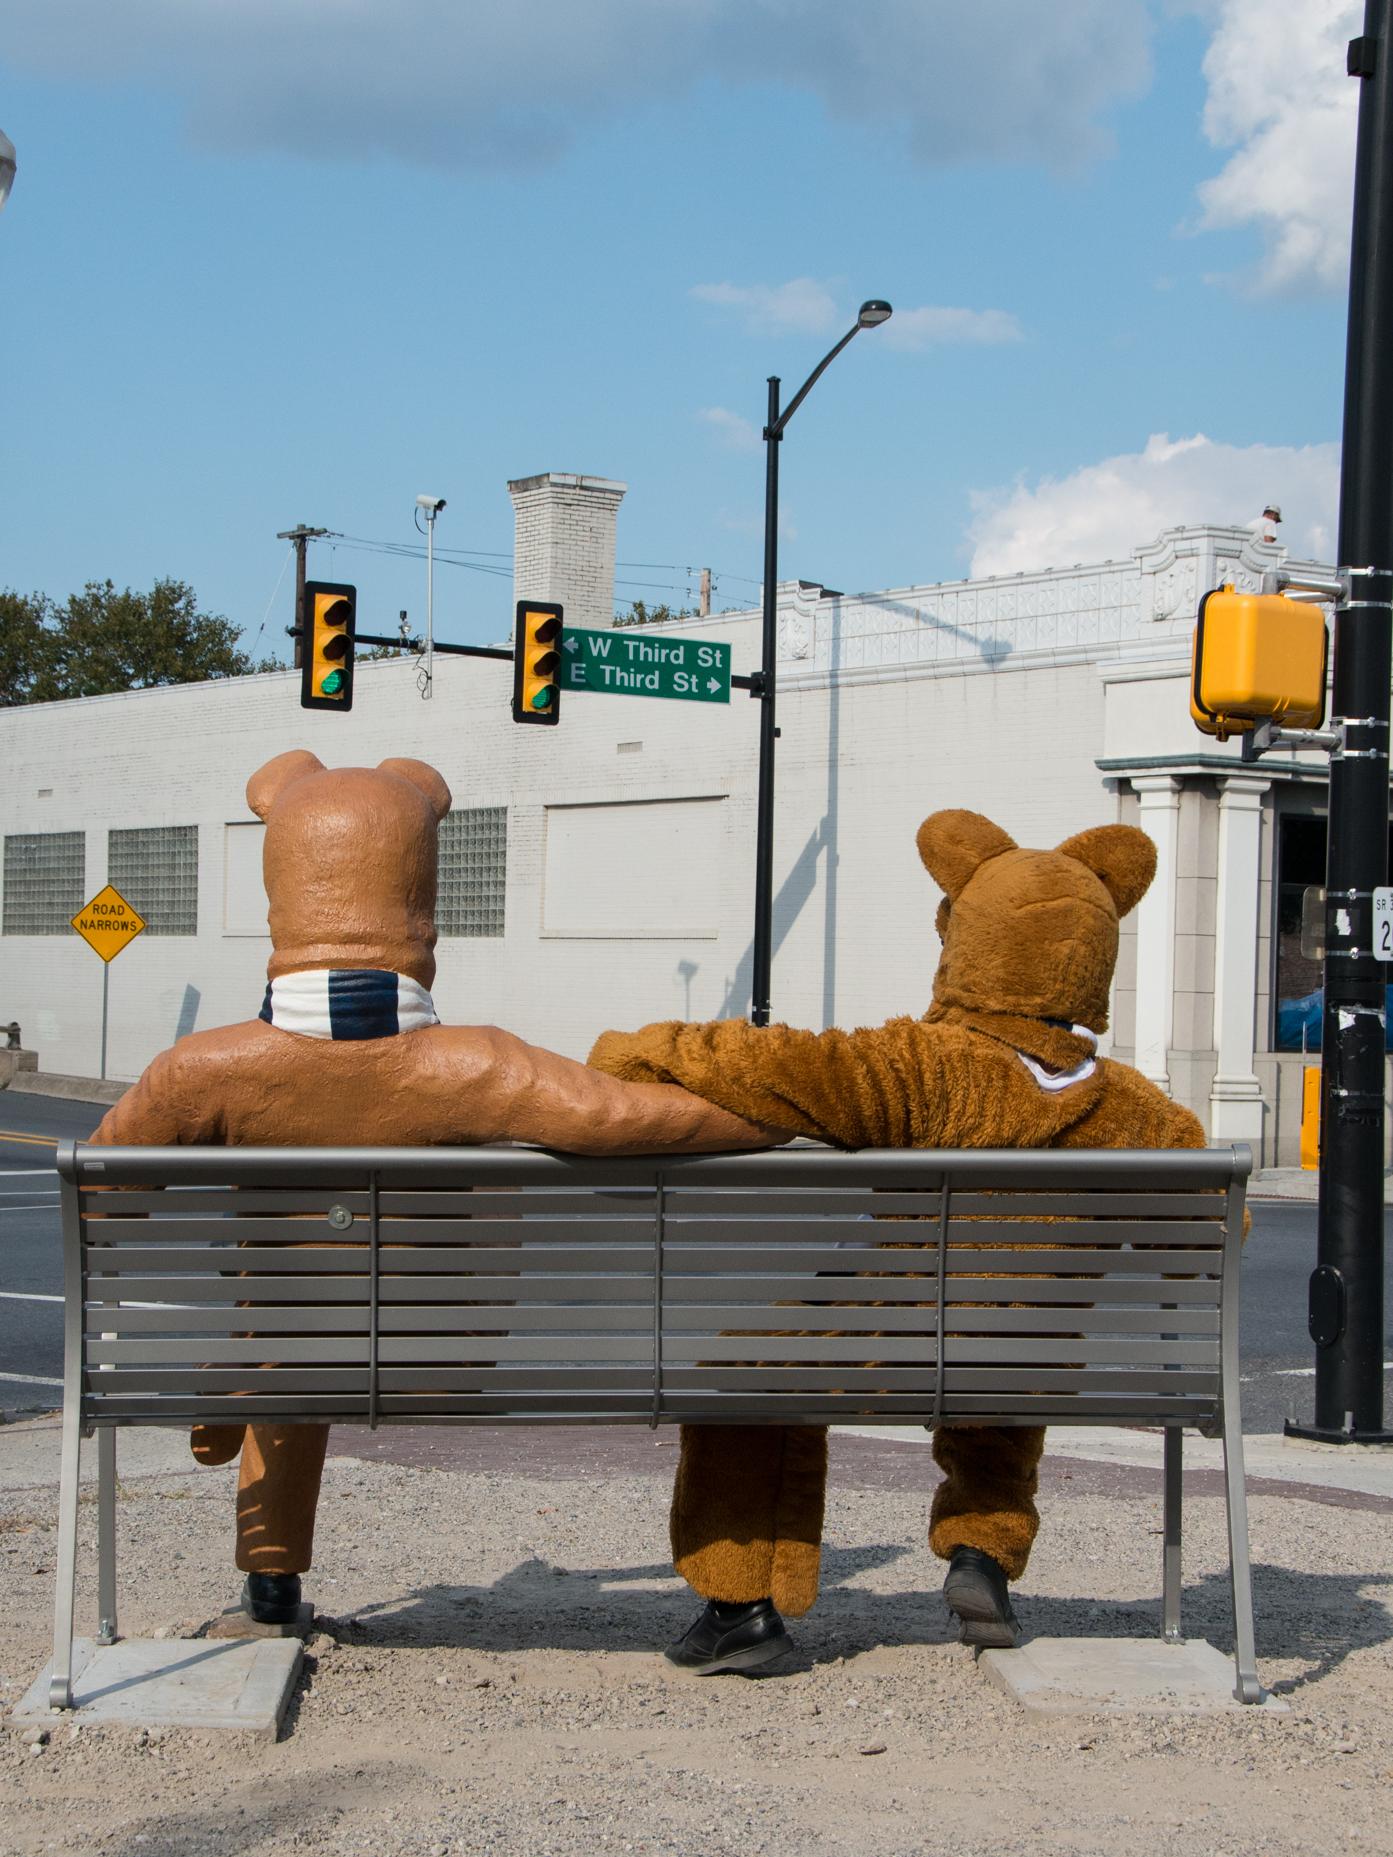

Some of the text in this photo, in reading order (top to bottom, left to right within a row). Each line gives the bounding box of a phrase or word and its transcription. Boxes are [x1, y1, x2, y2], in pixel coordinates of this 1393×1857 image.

[588, 636, 723, 668] W Third St
[570, 662, 699, 693] E Third St
[92, 903, 126, 916] ROAD
[1376, 899, 1387, 911] SR
[80, 919, 137, 932] NARROWS
